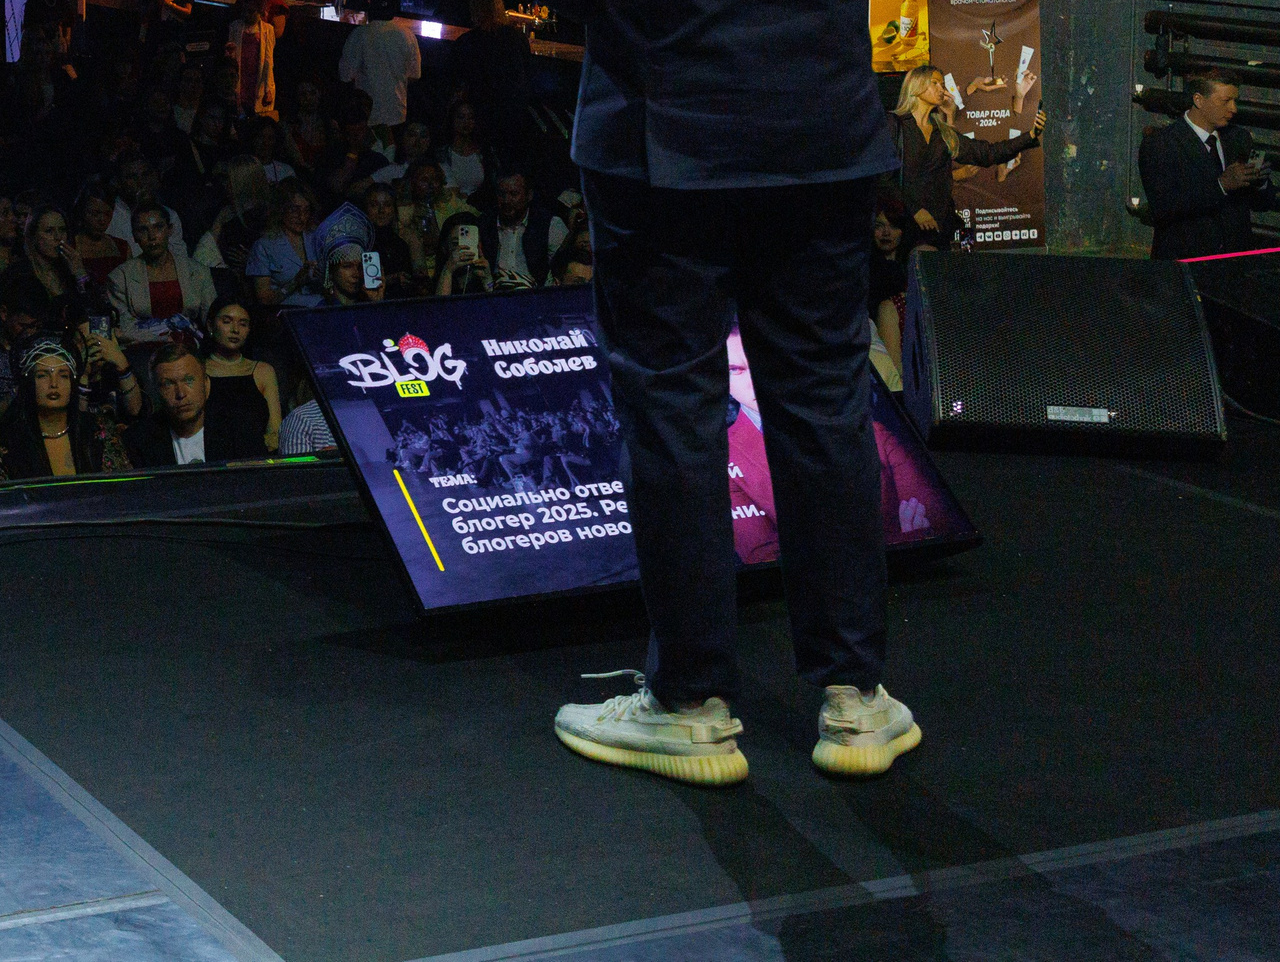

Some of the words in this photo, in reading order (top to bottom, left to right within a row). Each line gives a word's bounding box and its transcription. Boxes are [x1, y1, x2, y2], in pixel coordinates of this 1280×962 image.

[966, 111, 990, 119] ТОВАР
[990, 109, 1011, 118] ГОДА
[975, 206, 1019, 214] Подписывайтесь
[481, 329, 589, 357] Николай
[338, 339, 468, 394] BLOG
[493, 355, 598, 379] Соболев
[400, 382, 424, 395] FEST
[429, 473, 478, 489] ТЕМА:
[442, 484, 571, 515] Социально
[574, 480, 625, 501] отве
[451, 508, 535, 534] блогер
[540, 502, 599, 524] 2025.
[600, 498, 629, 516] Ре
[461, 526, 574, 555] блогеров
[577, 520, 633, 540] ново
